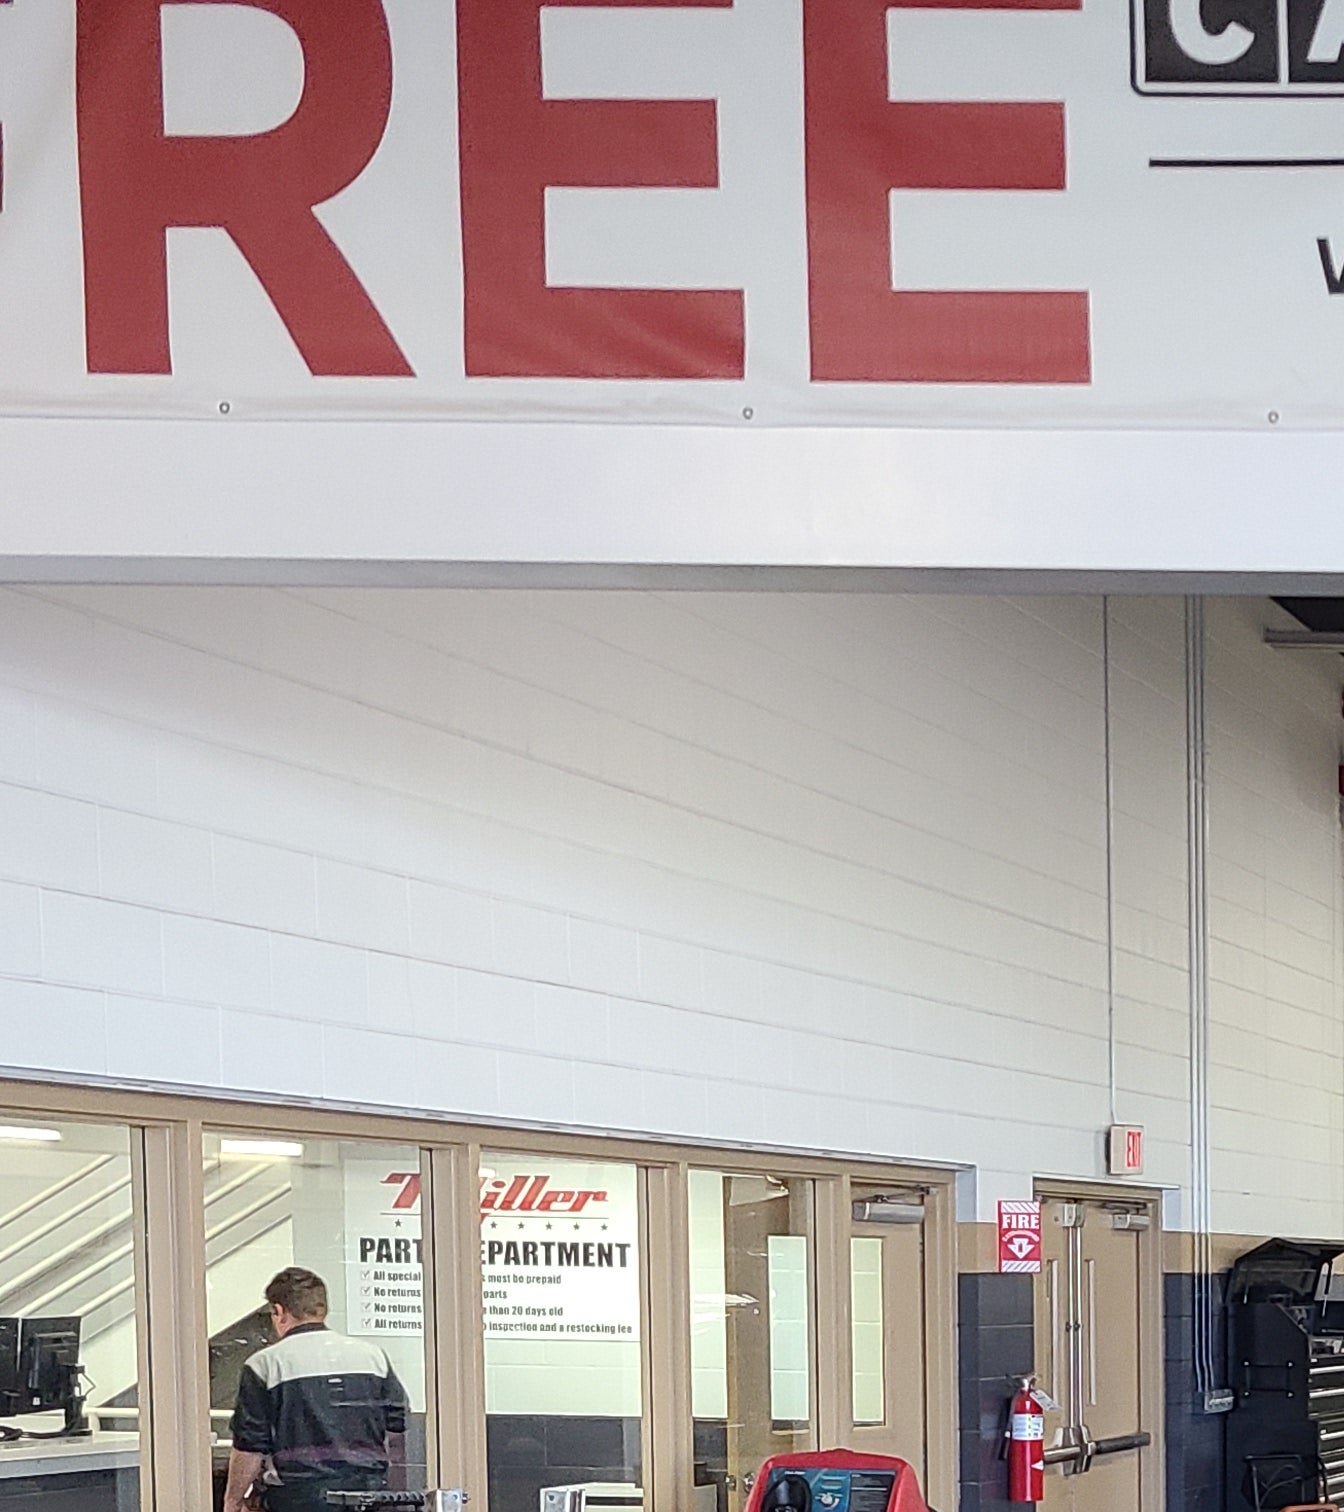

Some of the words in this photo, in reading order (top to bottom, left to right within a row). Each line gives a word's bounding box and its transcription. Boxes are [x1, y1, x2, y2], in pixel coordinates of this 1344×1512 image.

[0, 0, 1093, 384] REE
[1002, 1214, 1040, 1230] FIRE
[374, 1271, 386, 1281] All
[387, 1271, 421, 1283] special
[488, 1274, 511, 1284] must
[526, 1275, 562, 1285] prepaid
[374, 1287, 386, 1297] No
[387, 1287, 421, 1298] returns
[374, 1303, 386, 1313] No
[388, 1303, 422, 1313] returns
[489, 1306, 510, 1315] than
[525, 1306, 547, 1317] days
[549, 1307, 564, 1316] old
[374, 1319, 387, 1329] All
[388, 1319, 422, 1330] returns
[489, 1321, 538, 1333] inspection
[539, 1323, 557, 1332] and
[566, 1324, 616, 1335] restocking
[618, 1324, 632, 1334] fee
